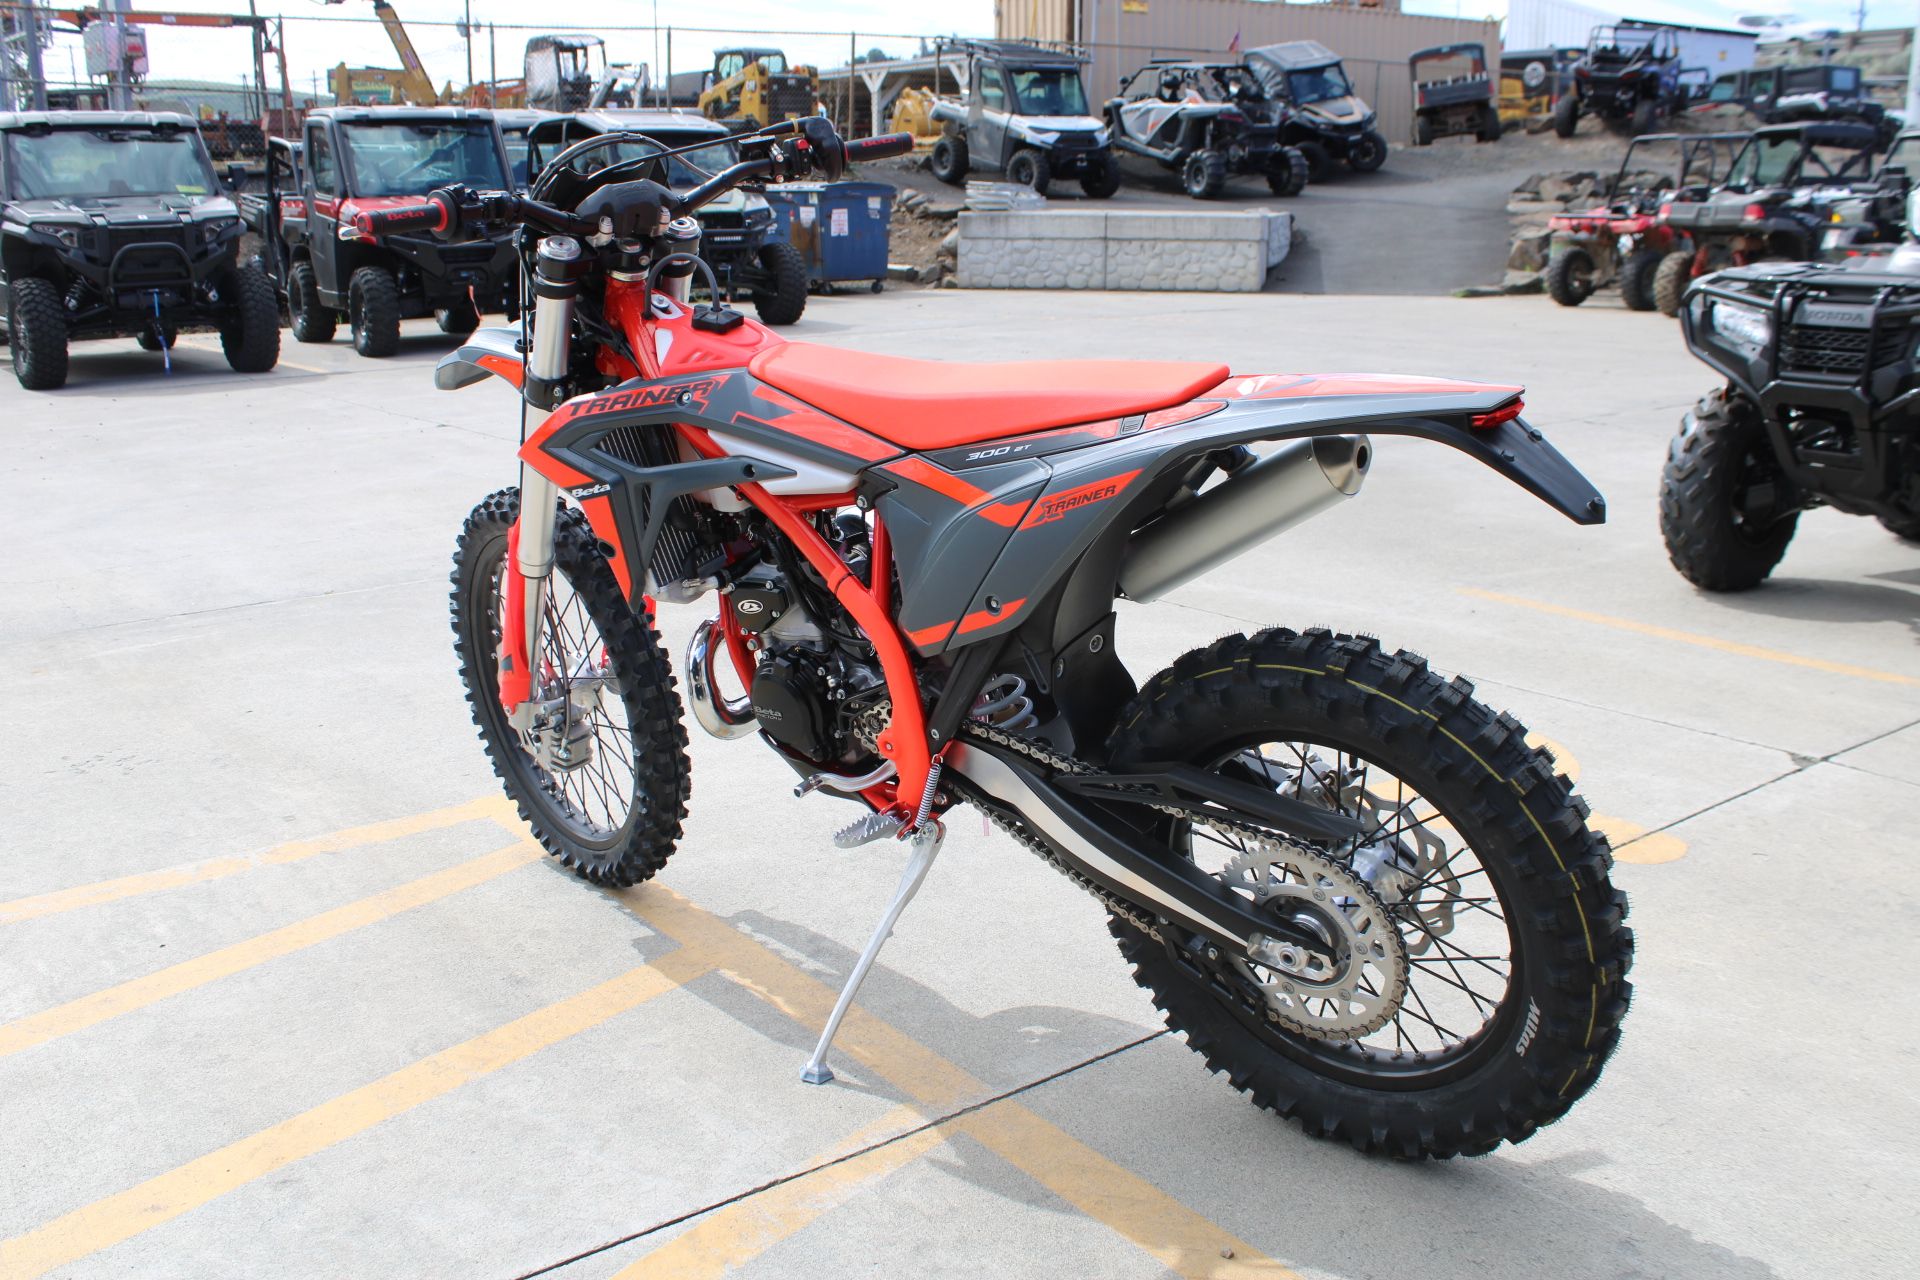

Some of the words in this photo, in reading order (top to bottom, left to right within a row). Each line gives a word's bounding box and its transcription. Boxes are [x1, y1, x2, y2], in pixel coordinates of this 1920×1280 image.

[386, 210, 425, 220] Beta
[966, 446, 1011, 461] 300
[571, 483, 611, 498] Beta
[753, 705, 782, 717] Beta
[1515, 996, 1541, 1057] Mitas
